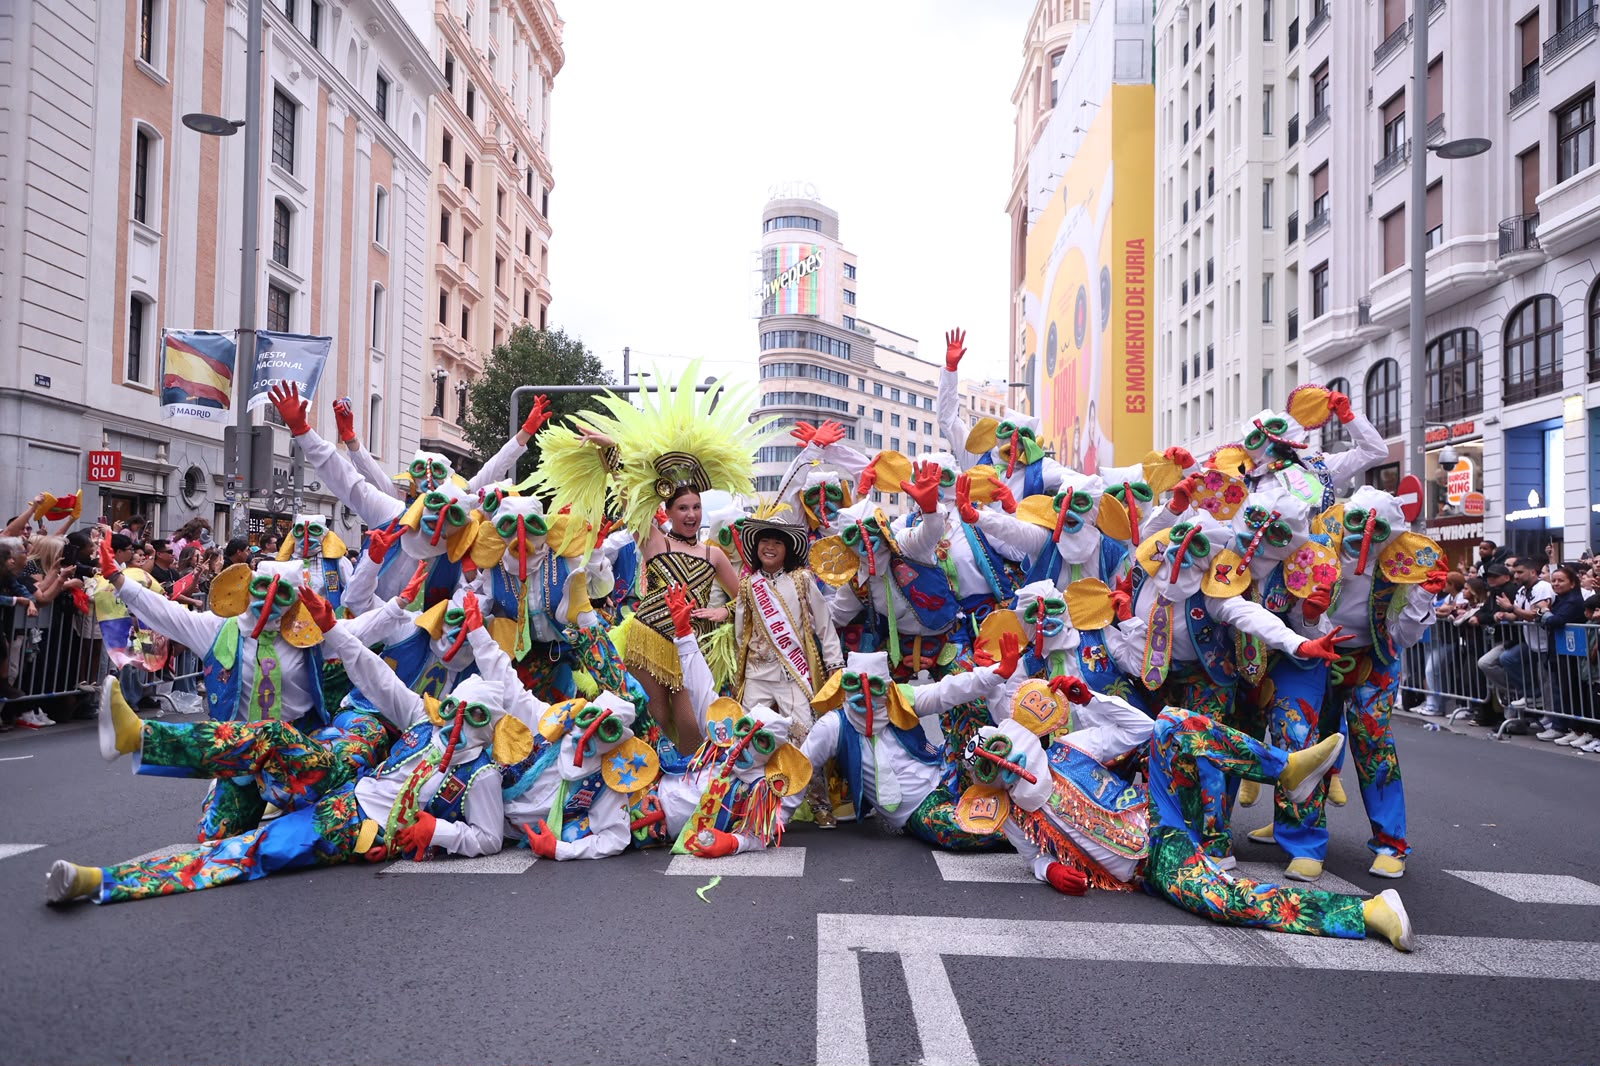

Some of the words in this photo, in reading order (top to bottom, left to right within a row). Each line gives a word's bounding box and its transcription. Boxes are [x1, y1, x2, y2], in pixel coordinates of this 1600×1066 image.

[1126, 238, 1145, 284] FURIA
[1126, 287, 1145, 307] DE
[258, 351, 286, 361] FIESTA
[1126, 310, 1145, 391] MOMENTO
[256, 360, 304, 370] NACIONAL
[1126, 394, 1145, 414] ES
[176, 407, 211, 419] MADRID
[92, 455, 114, 466] UNI
[92, 467, 116, 480] QLO
[1449, 472, 1470, 483] BURGER
[1448, 481, 1470, 495] KING
[1440, 523, 1483, 541] WHOPPE
[751, 578, 779, 619] Carnaval
[769, 621, 785, 634] de
[775, 632, 793, 650] los
